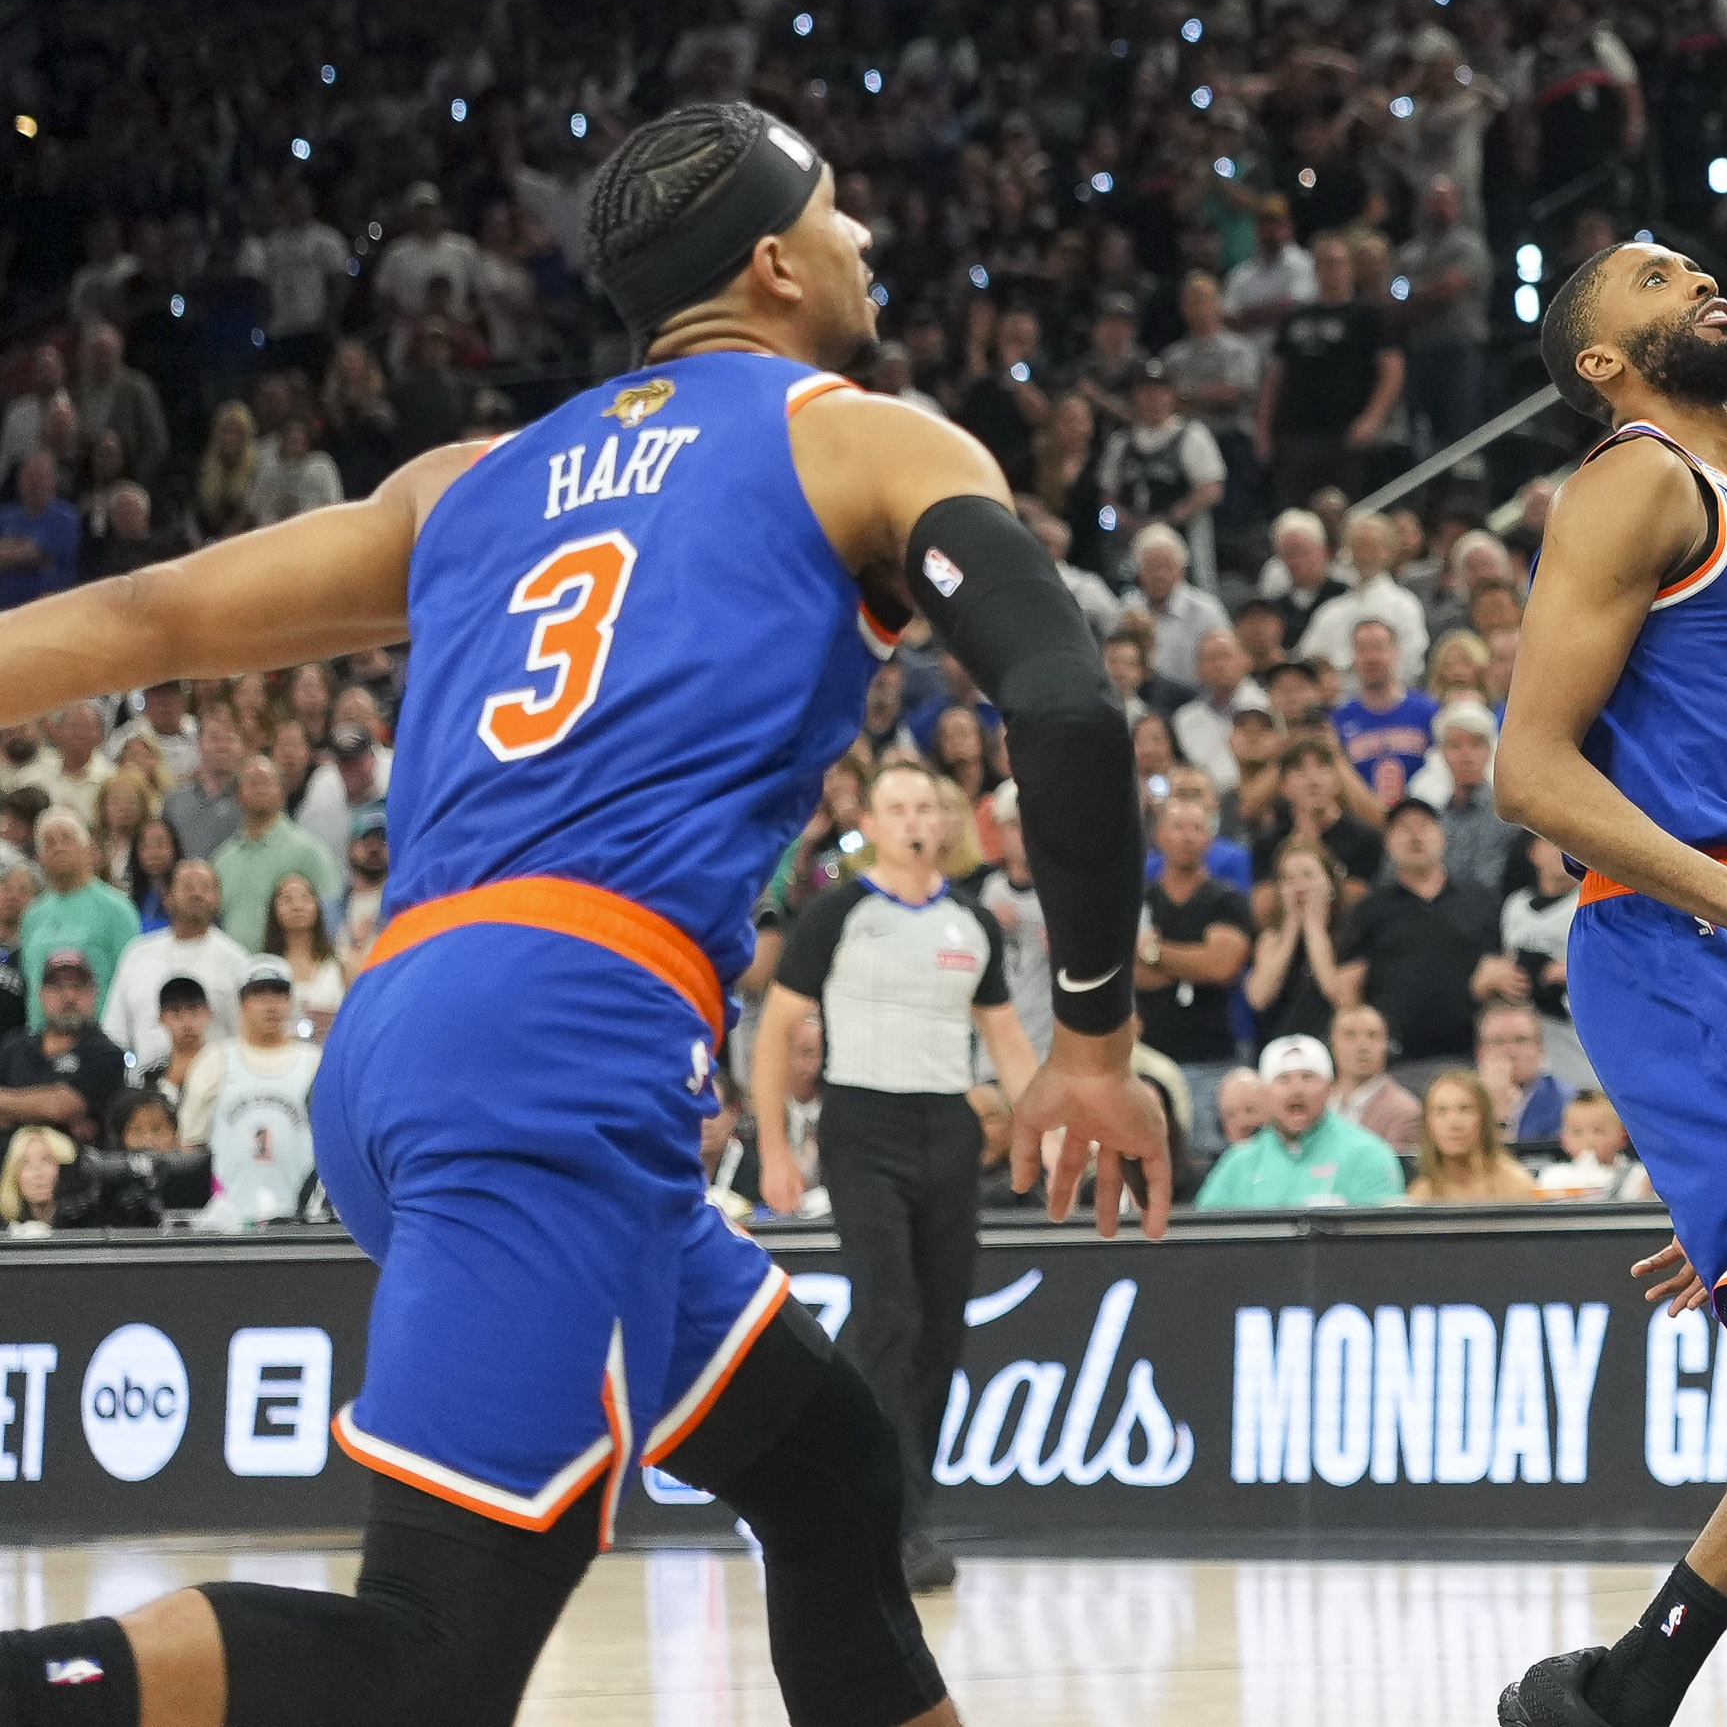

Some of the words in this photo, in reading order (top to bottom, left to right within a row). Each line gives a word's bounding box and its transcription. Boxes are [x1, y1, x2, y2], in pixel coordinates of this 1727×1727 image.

[544, 426, 701, 520] HART
[478, 529, 638, 763] 3
[93, 1374, 177, 1419] abc
[1230, 1301, 1611, 1488] MONDAY
